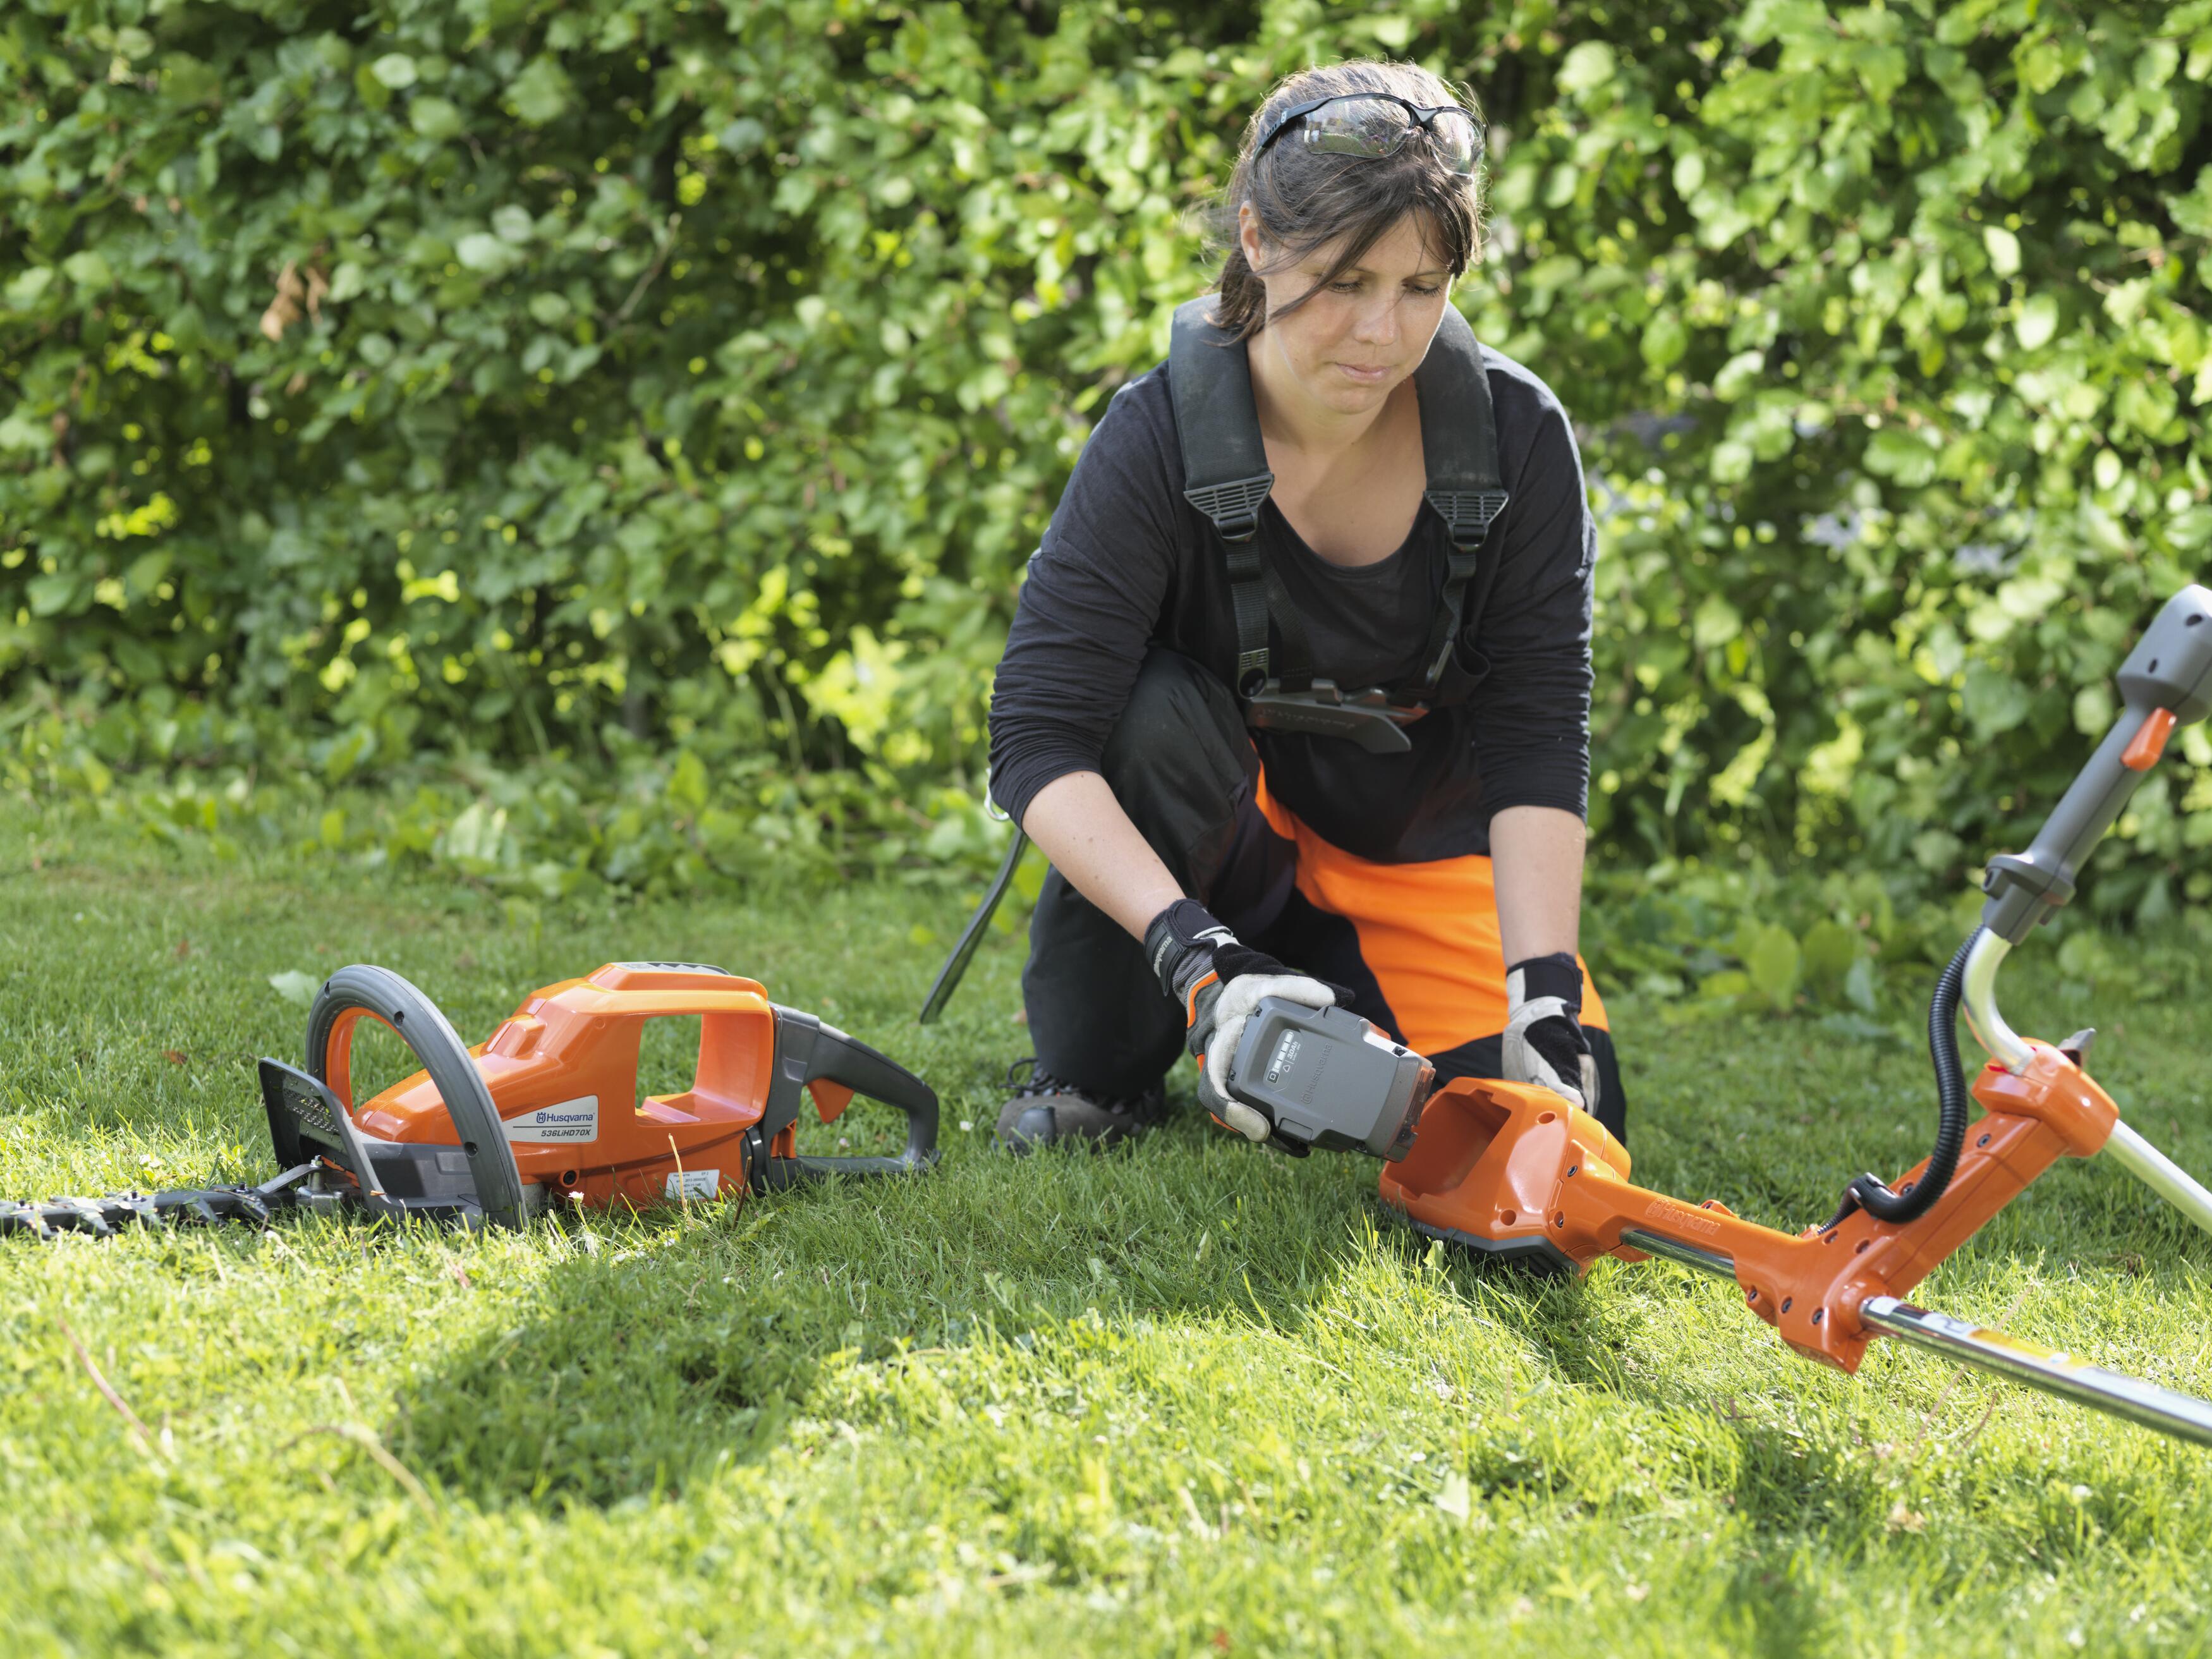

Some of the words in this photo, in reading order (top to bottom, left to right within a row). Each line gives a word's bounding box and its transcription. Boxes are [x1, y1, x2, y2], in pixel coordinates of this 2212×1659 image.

[1305, 1042, 1333, 1093] Husqvarna
[547, 1113, 593, 1123] Husqvarna
[540, 1129, 592, 1137] 536LiHD70X
[1657, 1203, 1720, 1236] Husqvarna
